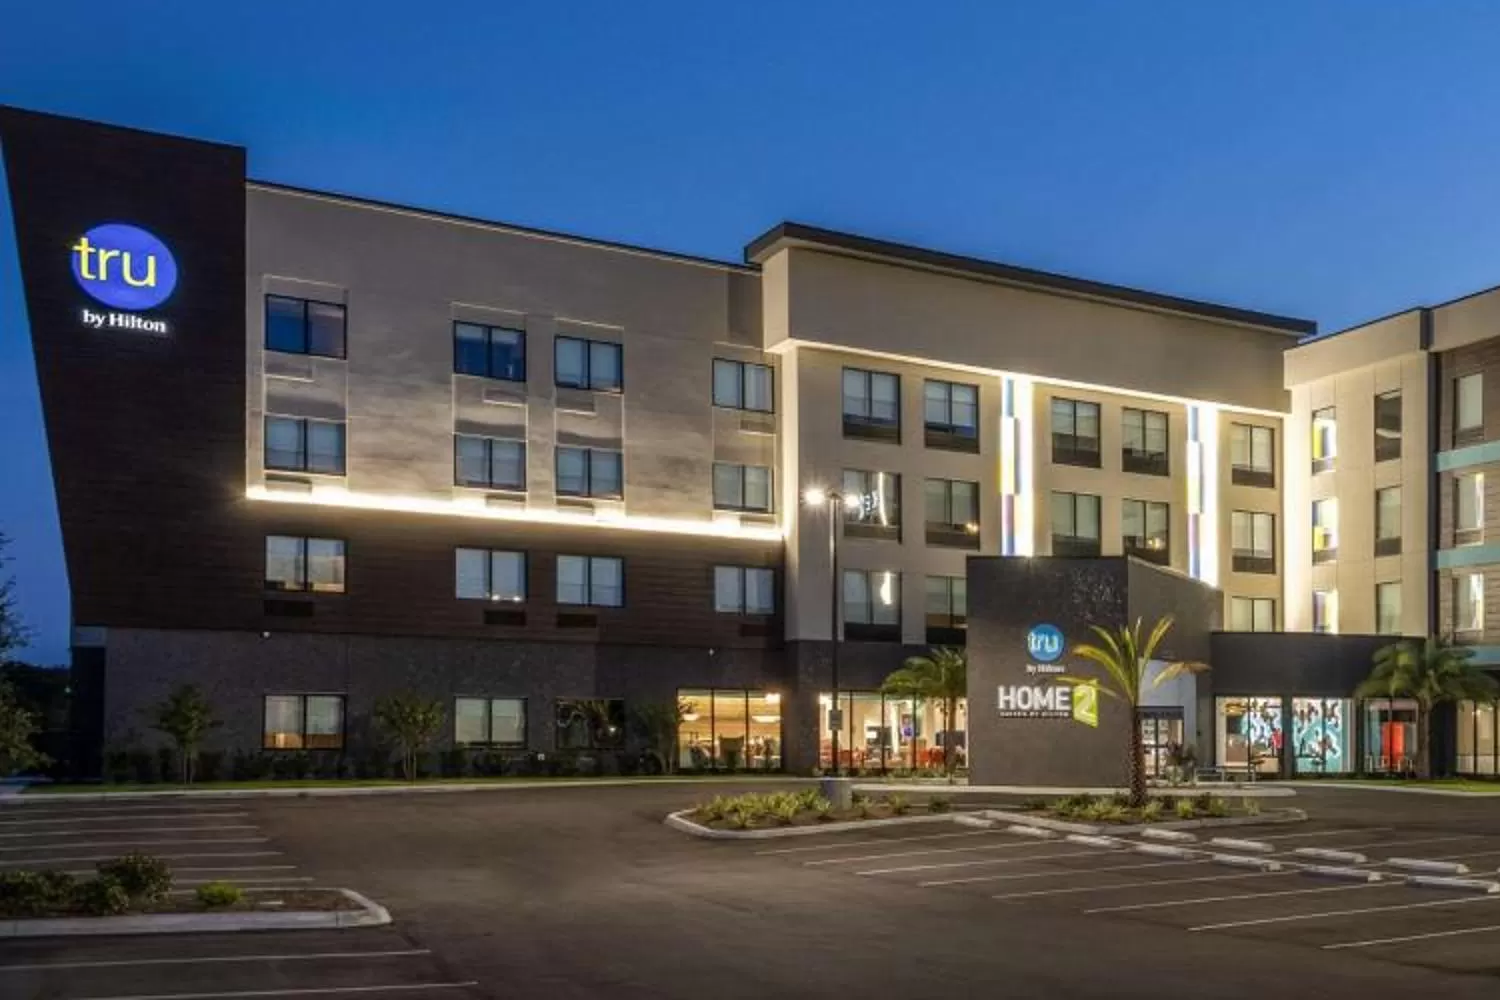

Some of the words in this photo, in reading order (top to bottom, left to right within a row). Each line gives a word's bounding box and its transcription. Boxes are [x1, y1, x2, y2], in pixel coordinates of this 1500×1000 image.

[72, 237, 156, 287] tru
[82, 309, 105, 328] by
[109, 313, 166, 332] Hilton
[1027, 632, 1059, 653] tru
[998, 686, 1071, 711] HOME
